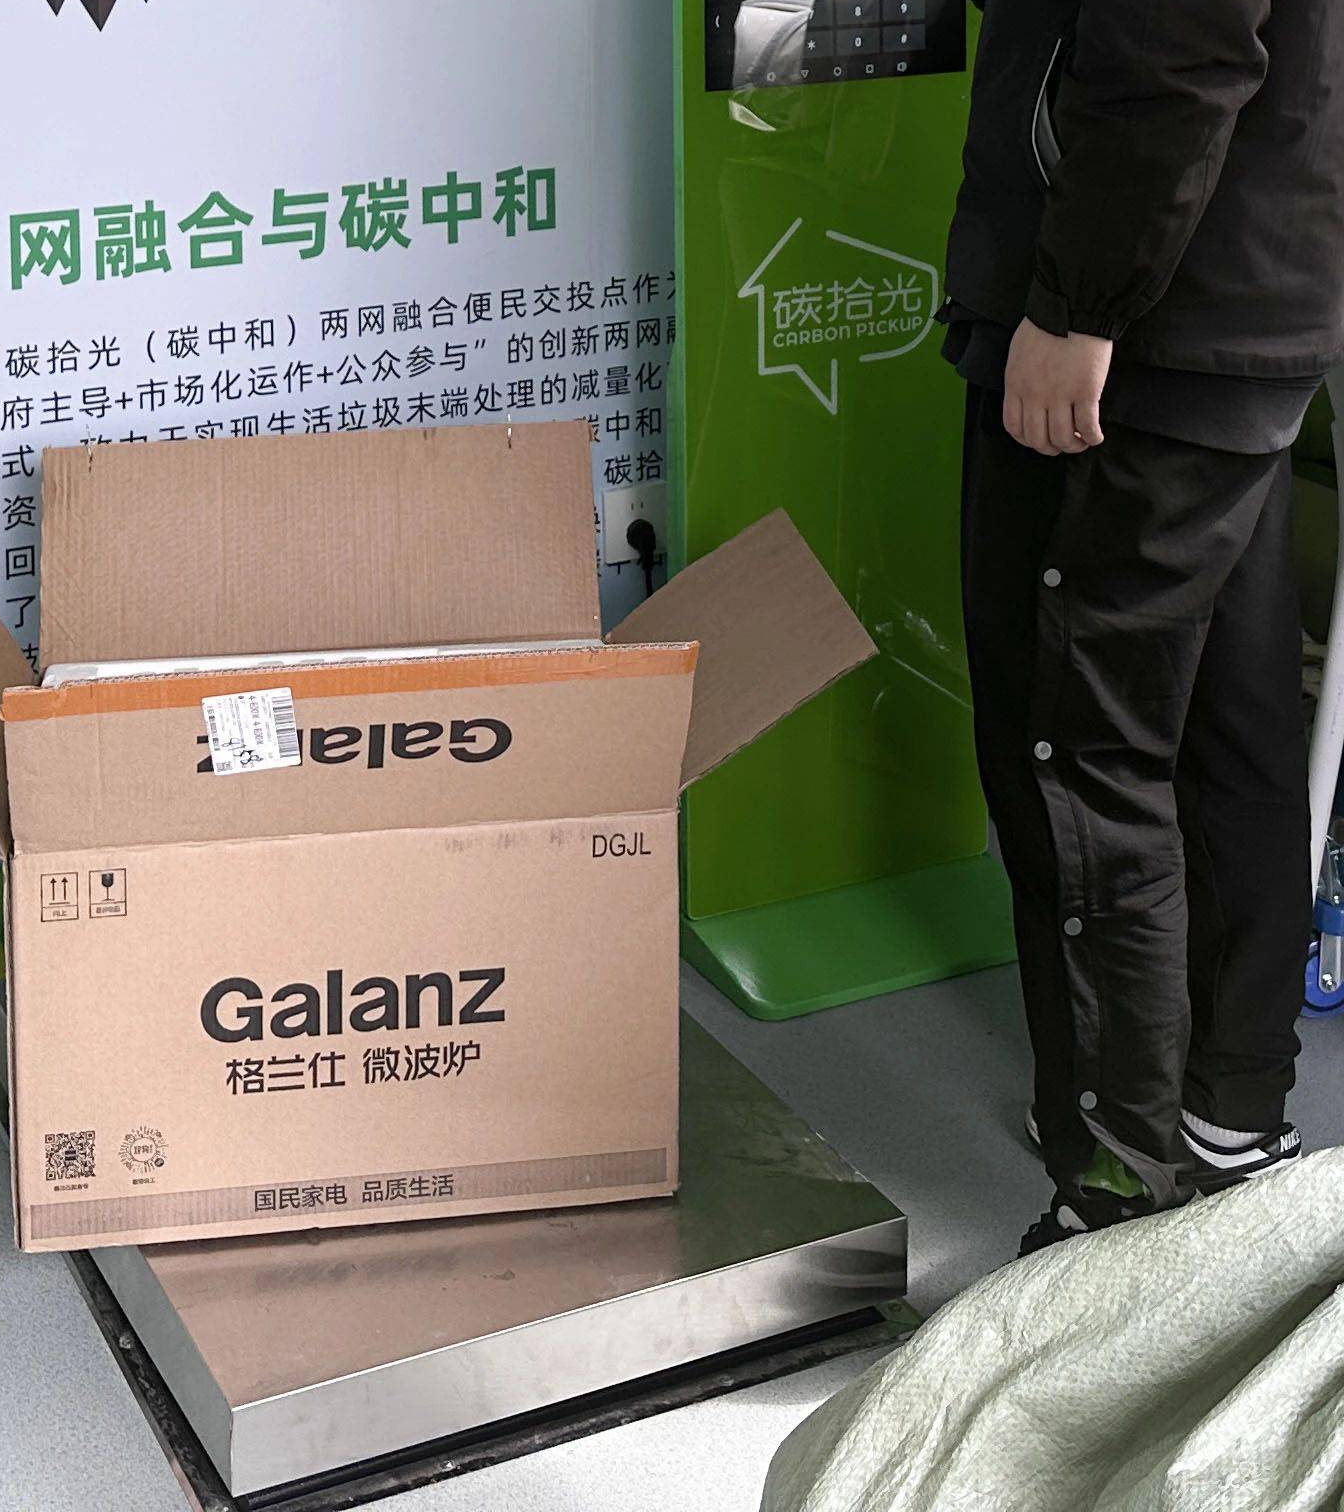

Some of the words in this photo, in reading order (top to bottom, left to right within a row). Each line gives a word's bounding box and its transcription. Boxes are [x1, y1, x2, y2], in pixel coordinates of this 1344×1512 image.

[772, 272, 924, 330] 碳拾光
[773, 322, 851, 348] CARBON
[856, 316, 923, 338] PICKUP
[591, 832, 652, 859] DGJL
[199, 967, 507, 1043] Galanz
[225, 1051, 346, 1096] 格兰仕
[362, 1040, 482, 1084] 微波炉
[253, 1182, 348, 1212] 国民家电
[360, 1173, 455, 1203] 品质生活
